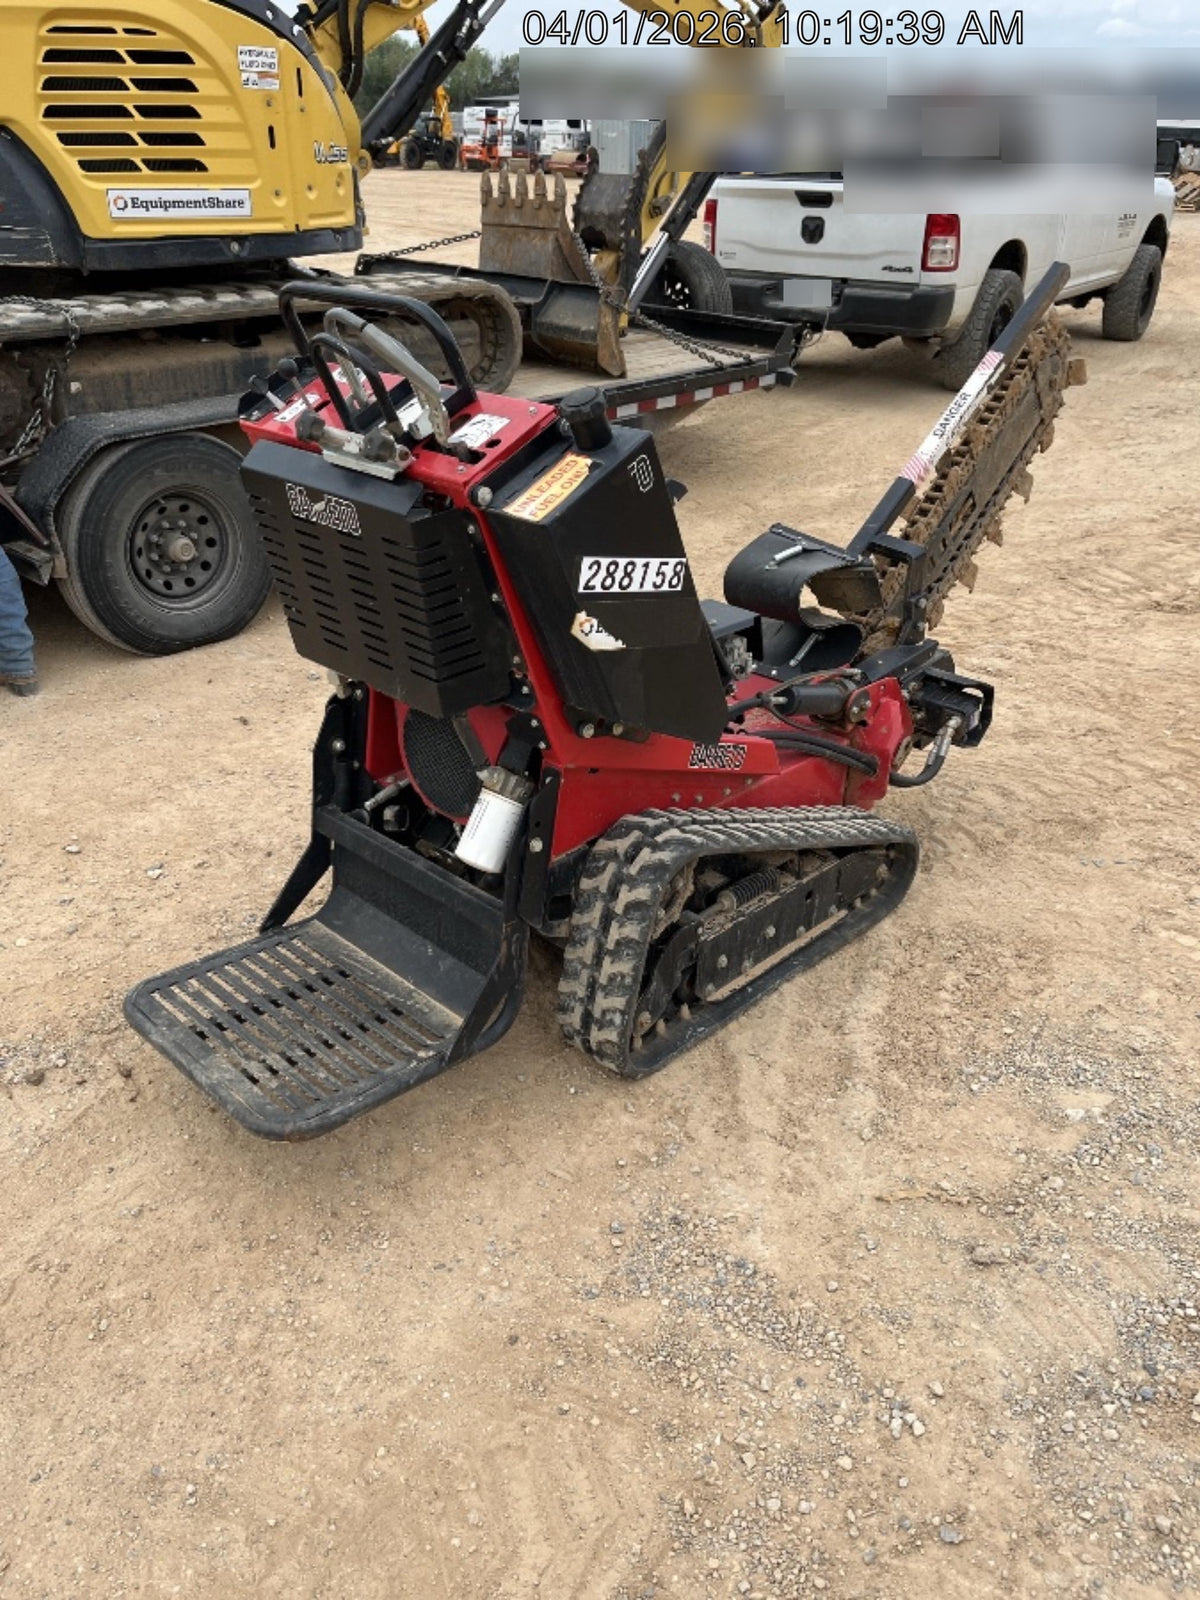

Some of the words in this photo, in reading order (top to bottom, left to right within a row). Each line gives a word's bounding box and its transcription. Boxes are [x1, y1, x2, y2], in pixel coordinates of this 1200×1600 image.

[130, 197, 245, 212] EquipmentShare
[933, 392, 971, 440] DANGER
[512, 459, 578, 514] UNLEADED
[529, 491, 564, 518] FUEL
[582, 559, 686, 591] 288158
